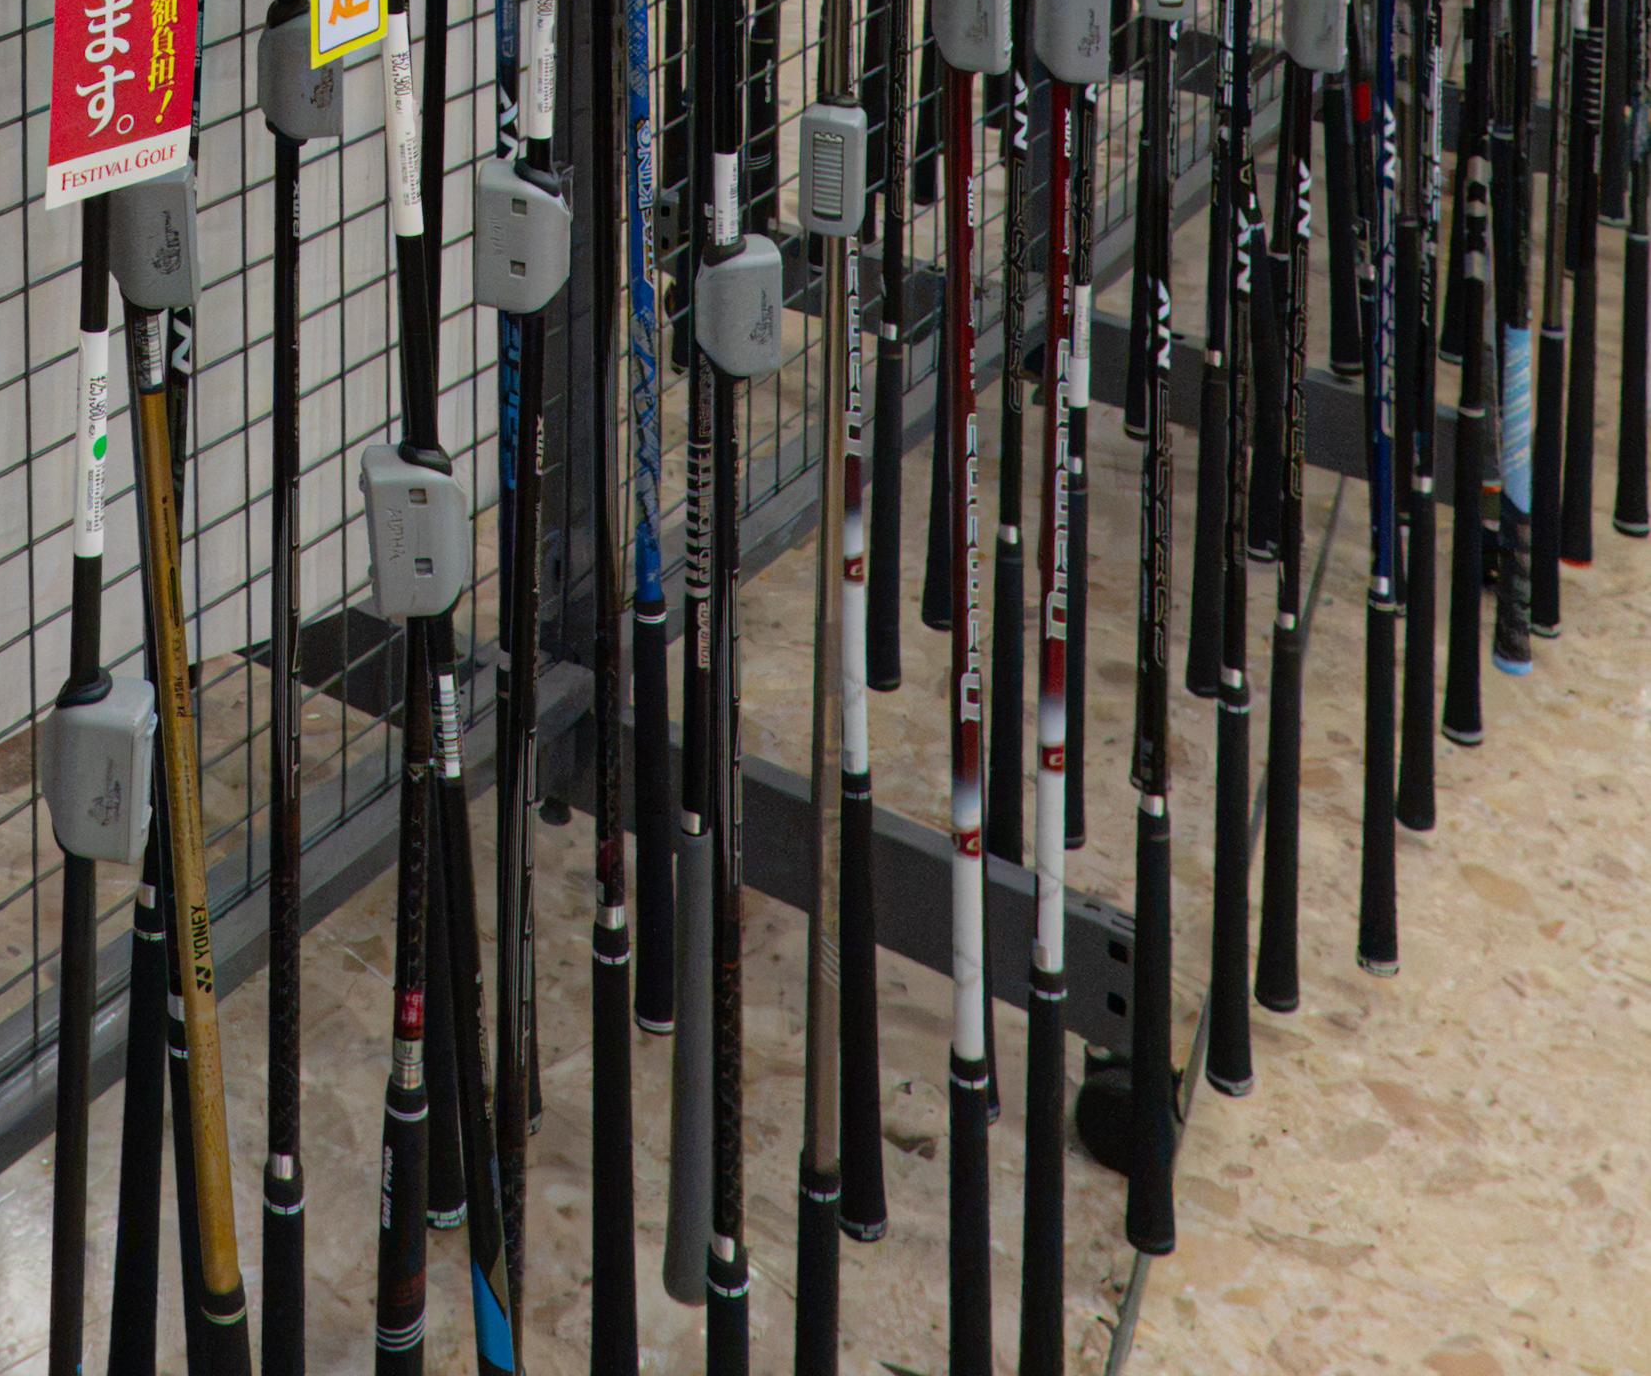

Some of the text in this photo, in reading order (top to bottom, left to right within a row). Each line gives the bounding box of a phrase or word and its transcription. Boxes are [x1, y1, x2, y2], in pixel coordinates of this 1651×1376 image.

[62, 144, 178, 191] FESTIVAL GOLF
[192, 904, 210, 961] YONEX
